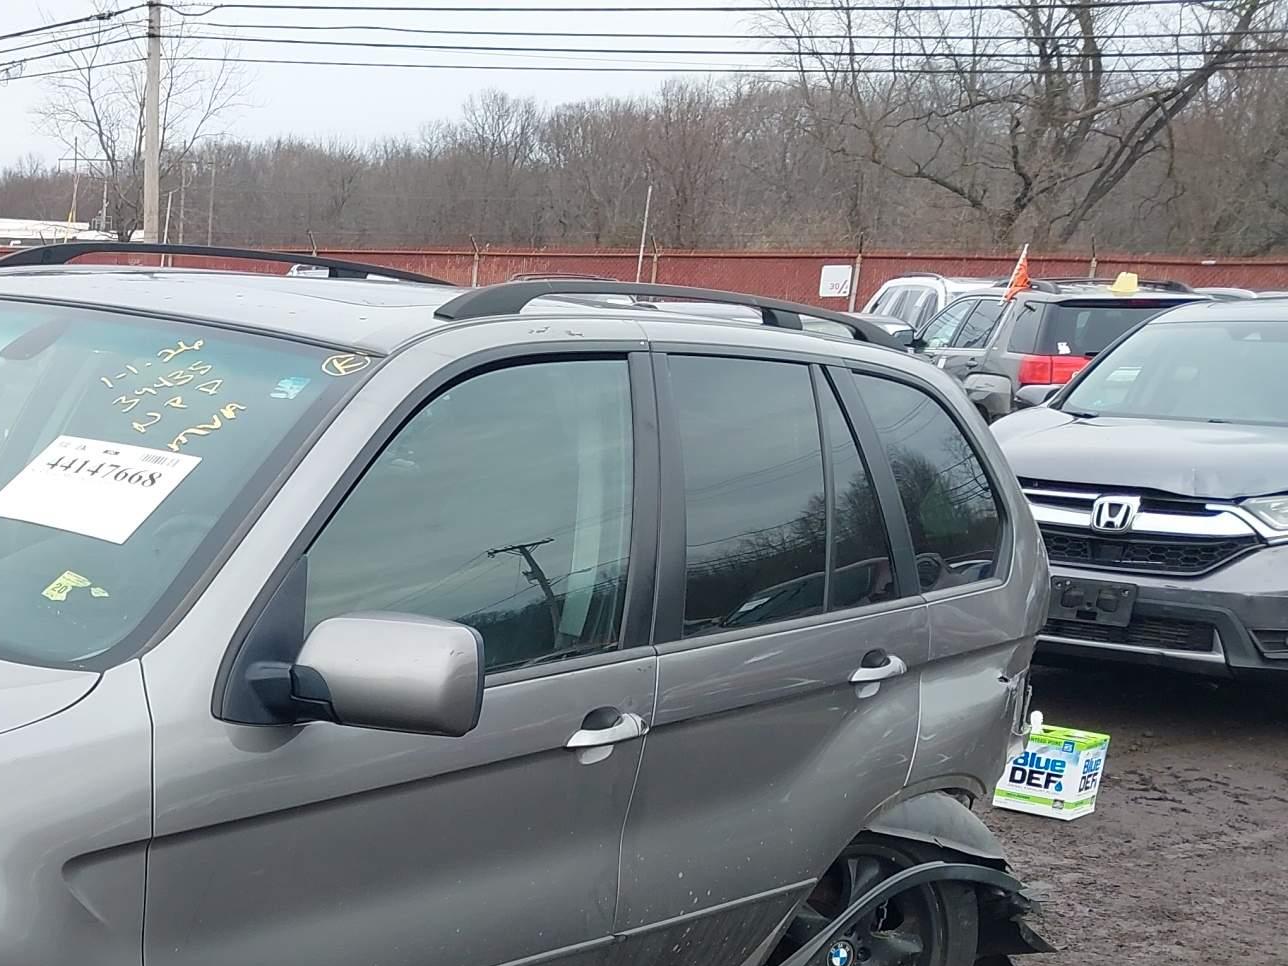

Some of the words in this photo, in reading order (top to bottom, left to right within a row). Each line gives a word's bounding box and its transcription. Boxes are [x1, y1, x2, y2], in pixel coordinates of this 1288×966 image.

[46, 455, 163, 488] 44147668
[1013, 751, 1066, 774] Blue
[1008, 766, 1064, 789] DEF
